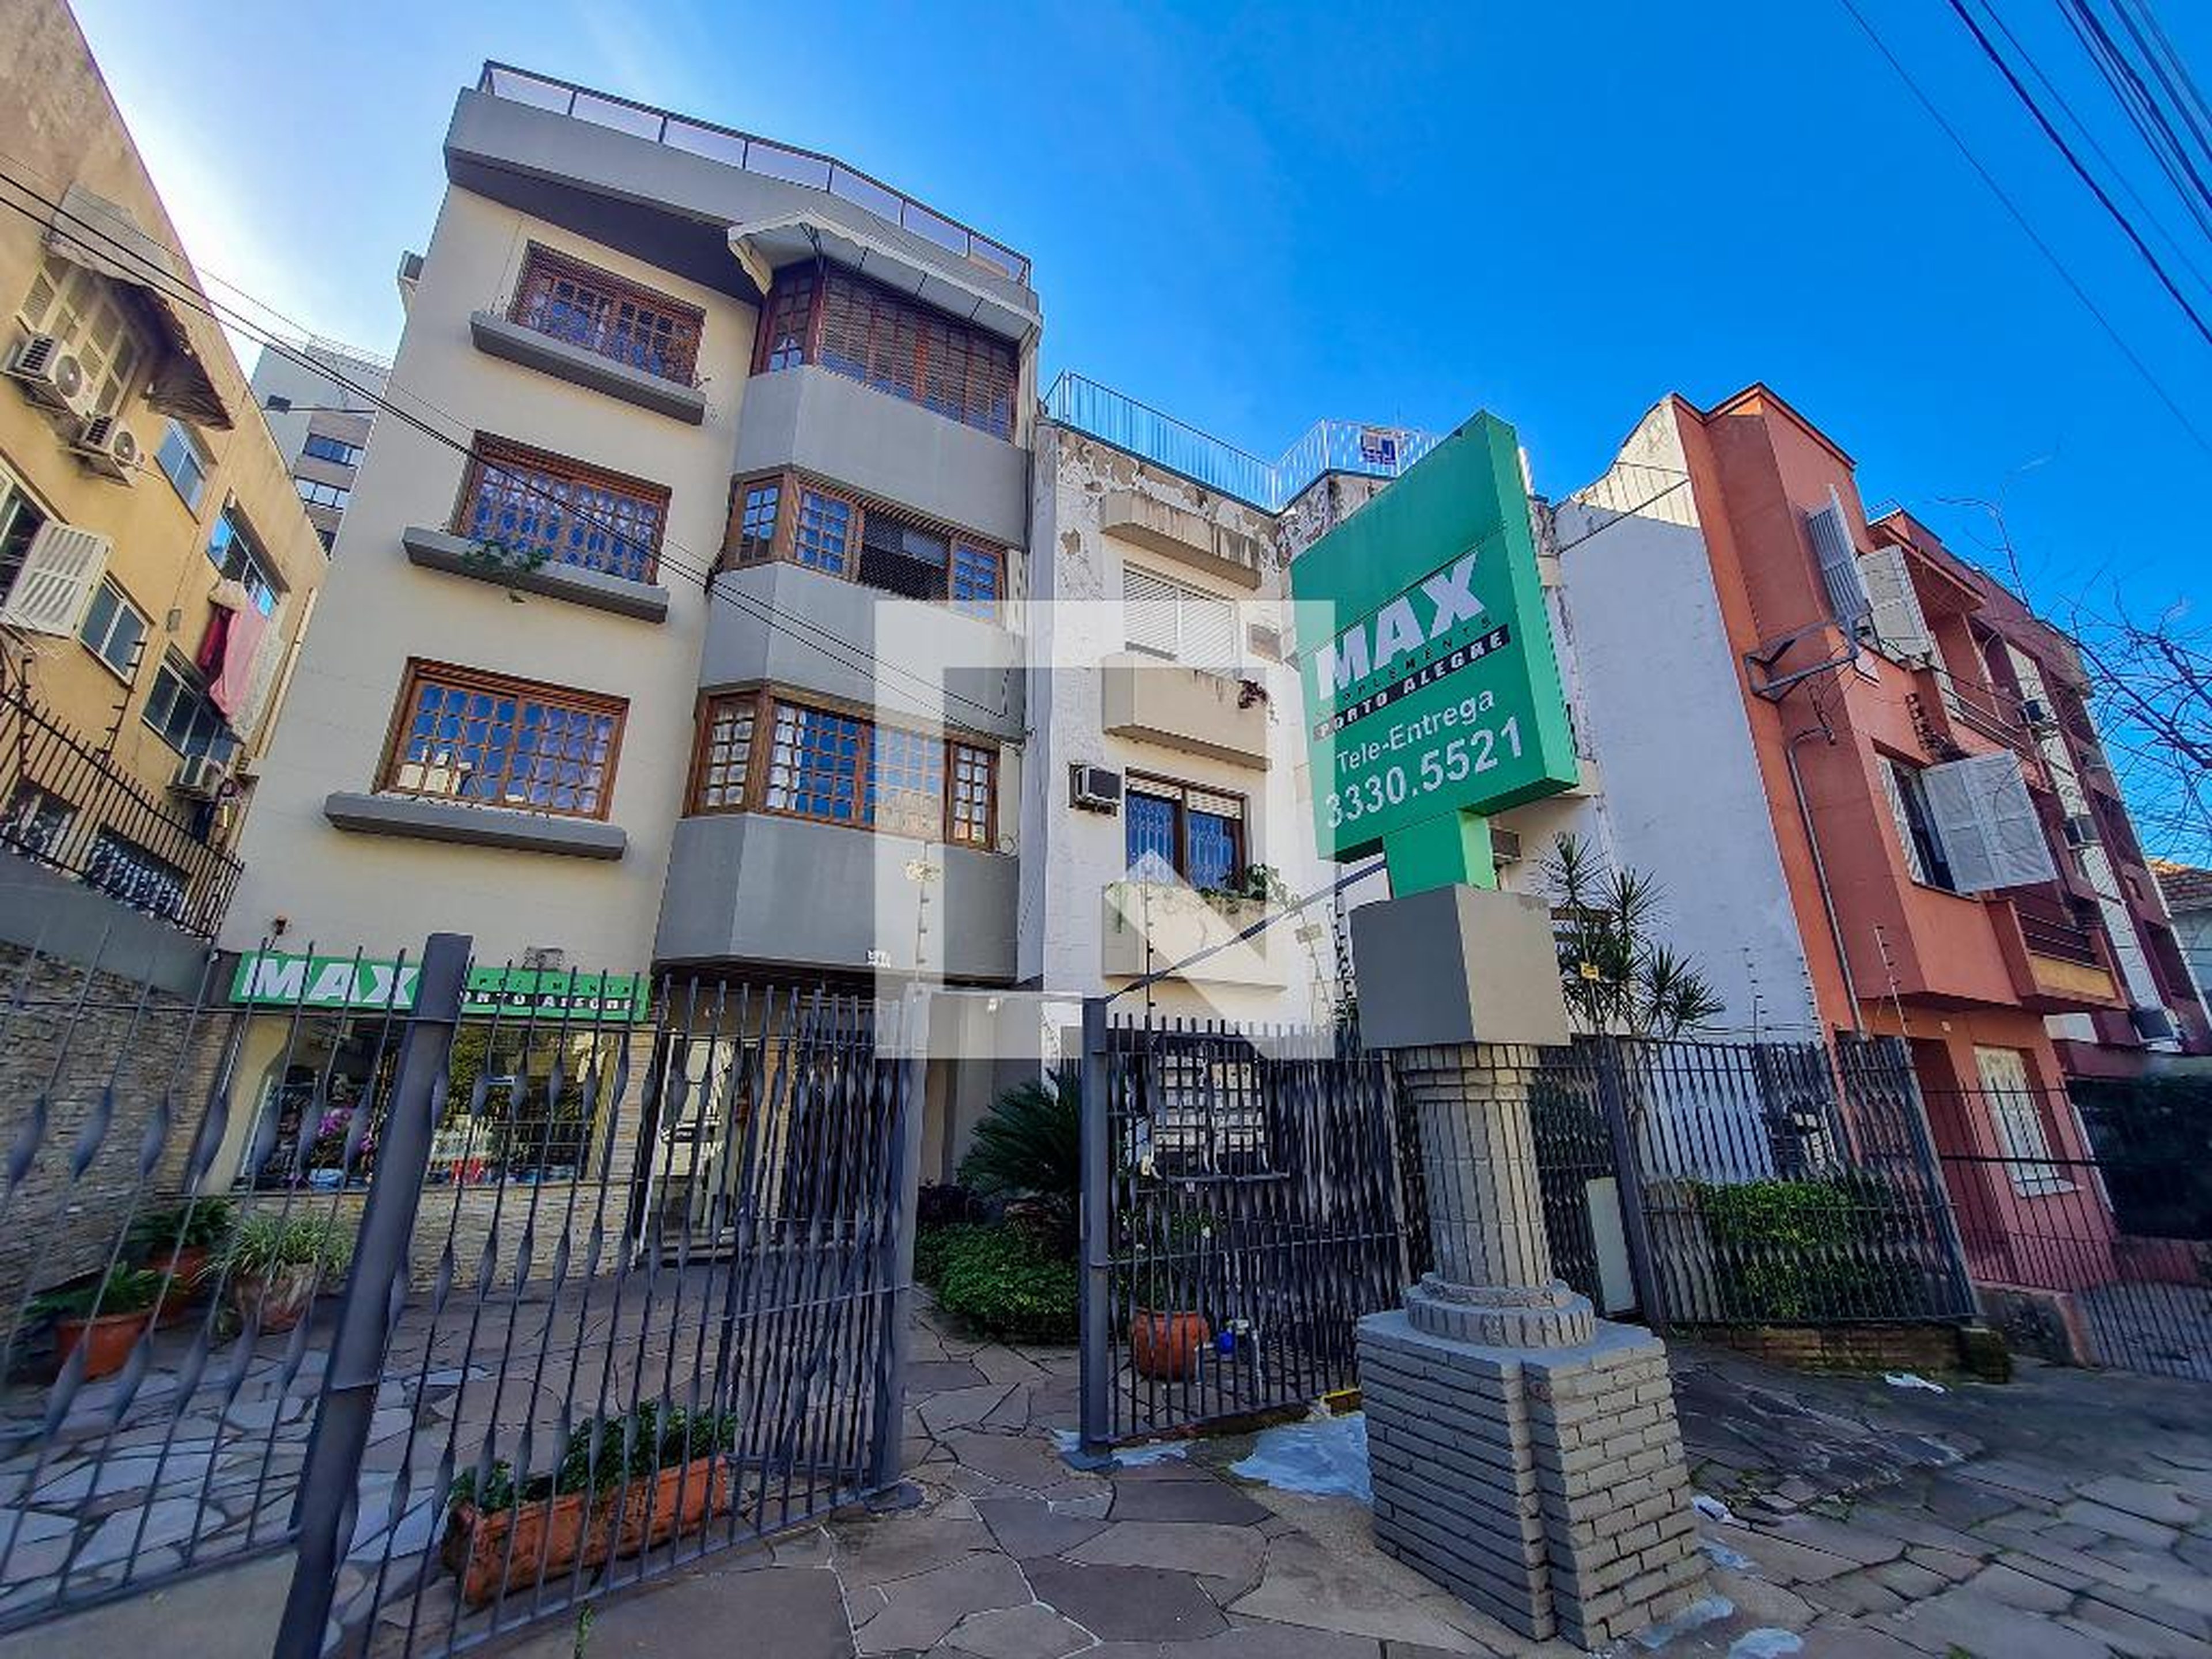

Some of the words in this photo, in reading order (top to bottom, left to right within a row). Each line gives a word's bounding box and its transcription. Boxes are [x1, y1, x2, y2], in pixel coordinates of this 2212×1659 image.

[1315, 551, 1484, 699] MAX
[1319, 691, 1388, 737] PORTO
[1403, 631, 1503, 695] ALEGRE
[1325, 716, 1522, 828] 3330.5521
[1337, 690, 1495, 775] Tele-Entrega
[241, 958, 419, 1005] MAX
[459, 990, 526, 1006] ORTO
